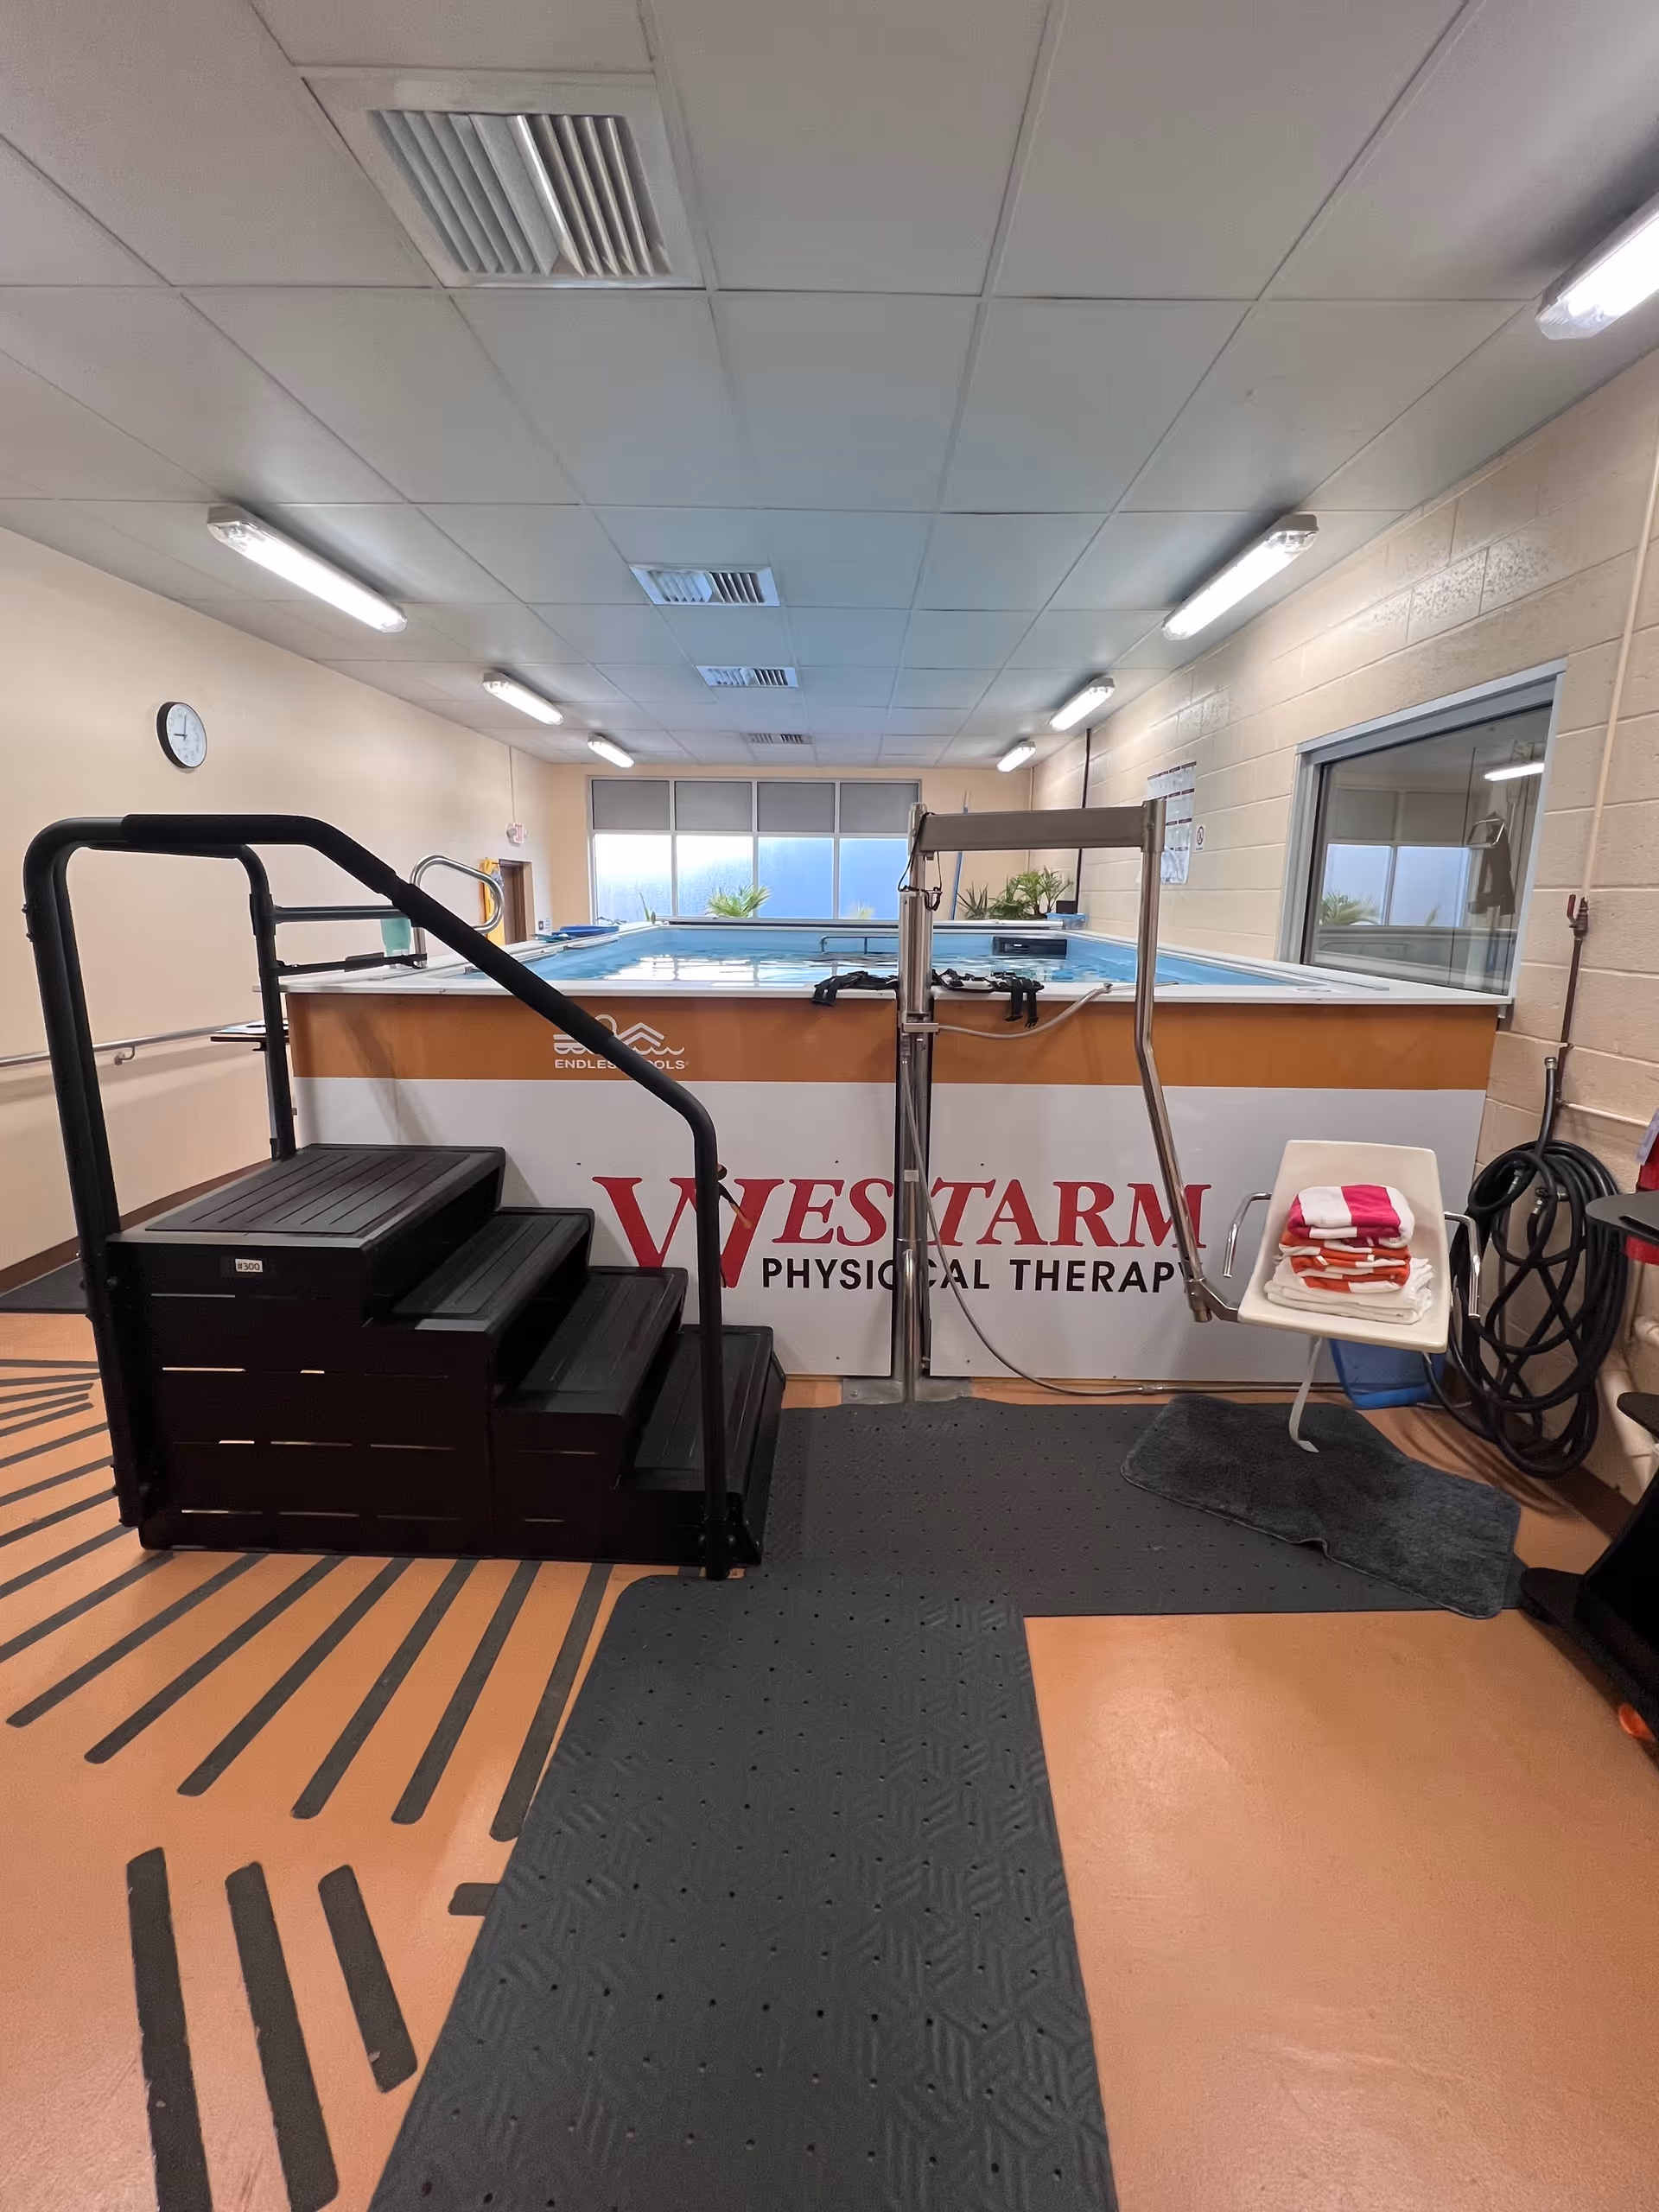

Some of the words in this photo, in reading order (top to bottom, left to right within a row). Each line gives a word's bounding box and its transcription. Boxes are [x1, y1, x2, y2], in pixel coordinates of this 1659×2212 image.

[554, 1059, 617, 1070] ENDLES
[646, 1059, 686, 1070] OLS
[592, 1176, 1211, 1288] WESTARM
[237, 1262, 260, 1271] #300
[1010, 1259, 1203, 1294] THERAP
